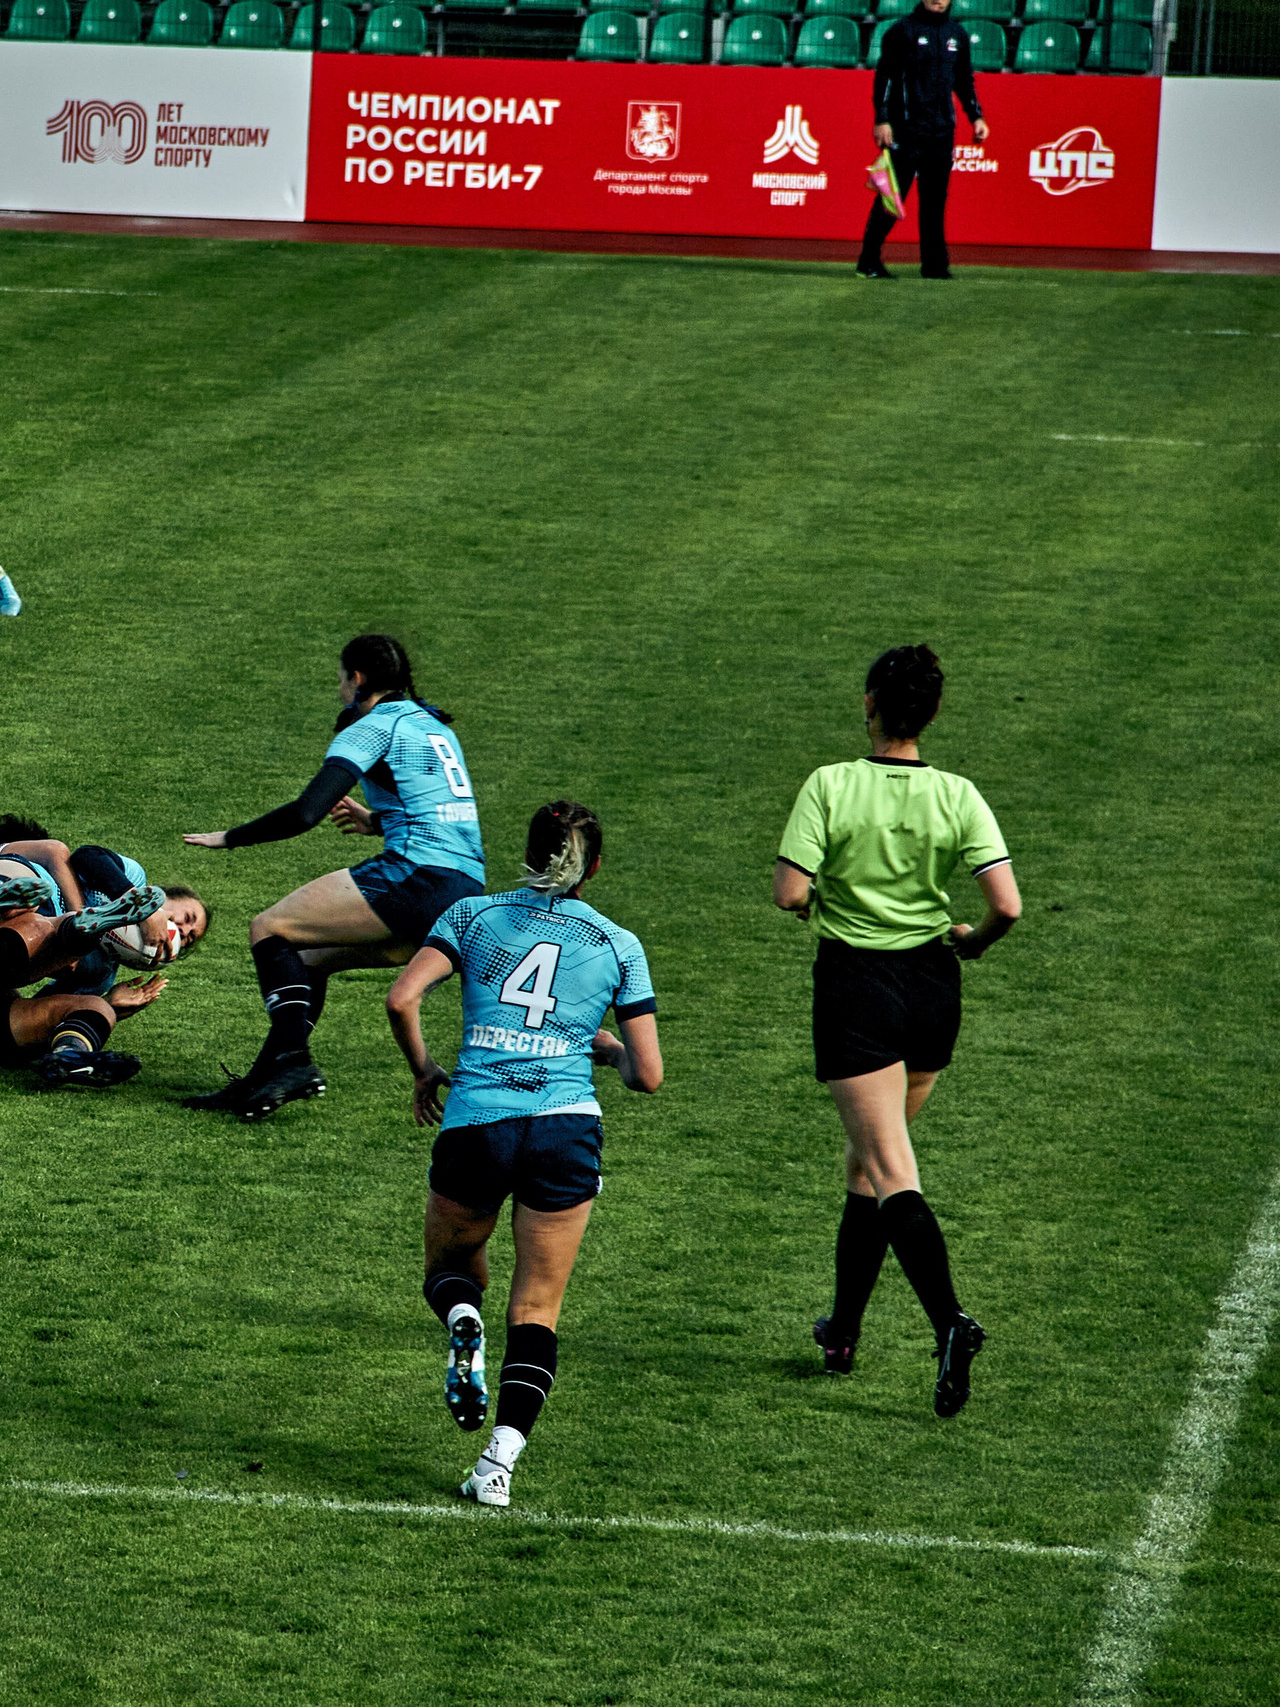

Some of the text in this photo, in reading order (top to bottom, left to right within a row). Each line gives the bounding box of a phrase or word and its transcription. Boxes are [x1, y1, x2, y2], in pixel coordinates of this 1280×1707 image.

[157, 103, 184, 123] ЛЕТ
[347, 90, 561, 125] ЧЕМПИОНАТ
[46, 100, 147, 165] 100
[156, 126, 270, 147] МОСКОВСКОМУ
[346, 123, 488, 156] РОССИИ
[155, 148, 212, 168] СПОРТУ
[952, 145, 985, 159] ГБИ
[1029, 150, 1115, 179] ЦПС
[344, 156, 543, 191] ПО РЕГБИ-7
[593, 168, 709, 184] Департамент спорта
[752, 171, 828, 190] МОСКОВСКИЙ
[607, 184, 692, 195] города Москвы
[770, 190, 807, 206] СПОРТ
[426, 733, 473, 798] 8
[500, 942, 562, 1030] 4
[470, 1025, 570, 1057] ПЕРЕСТЯК
